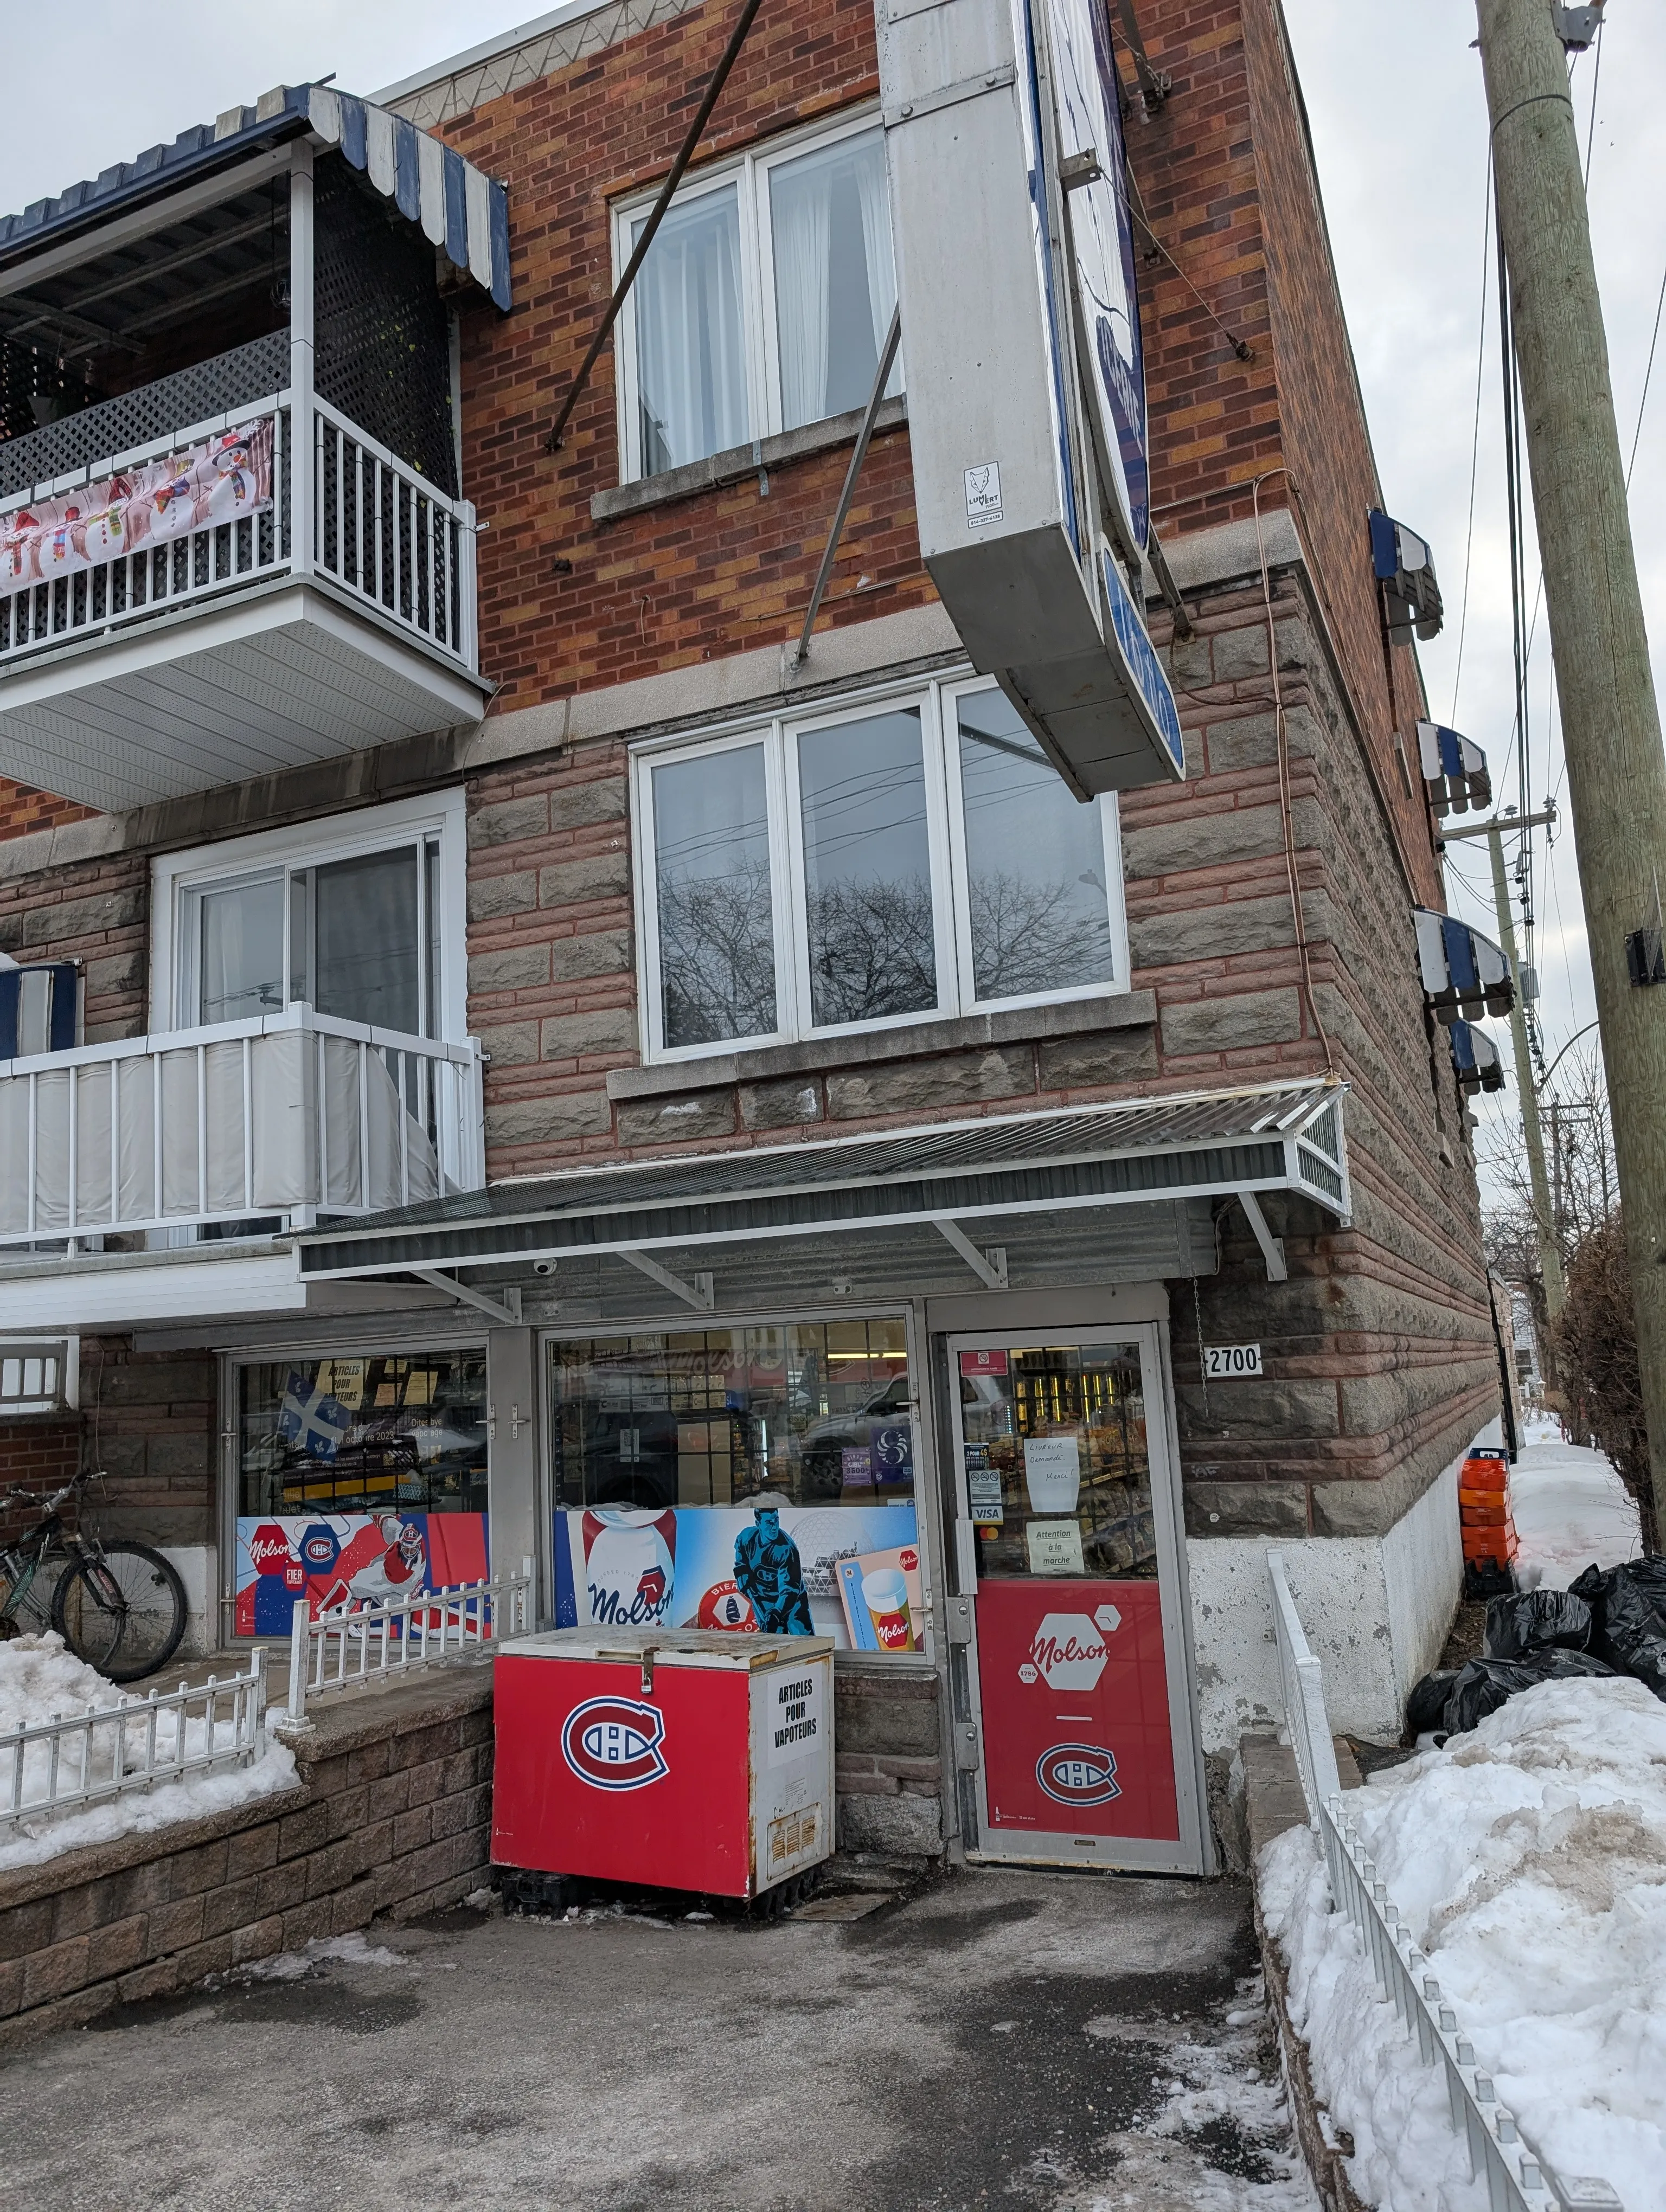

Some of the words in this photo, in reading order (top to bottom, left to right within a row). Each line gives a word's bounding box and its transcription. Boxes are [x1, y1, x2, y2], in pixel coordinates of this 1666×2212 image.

[1210, 1348, 1257, 1373] 2700
[411, 1418, 428, 1427] Dites
[430, 1418, 442, 1427] bye
[376, 1431, 394, 1441] 2023
[974, 1509, 999, 1519] VISA
[1036, 1529, 1071, 1539] Attention
[249, 1539, 291, 1565] Molson
[1043, 1557, 1071, 1565] marche
[286, 1569, 302, 1580] FIER
[711, 1583, 738, 1596] BIÈR
[588, 1581, 674, 1625] Molson
[877, 1622, 909, 1642] Molson
[1029, 1636, 1110, 1674] Molson
[778, 1678, 813, 1705] ARTICLES
[786, 1701, 806, 1723] POUR
[774, 1718, 817, 1748] VAPOTEURS
